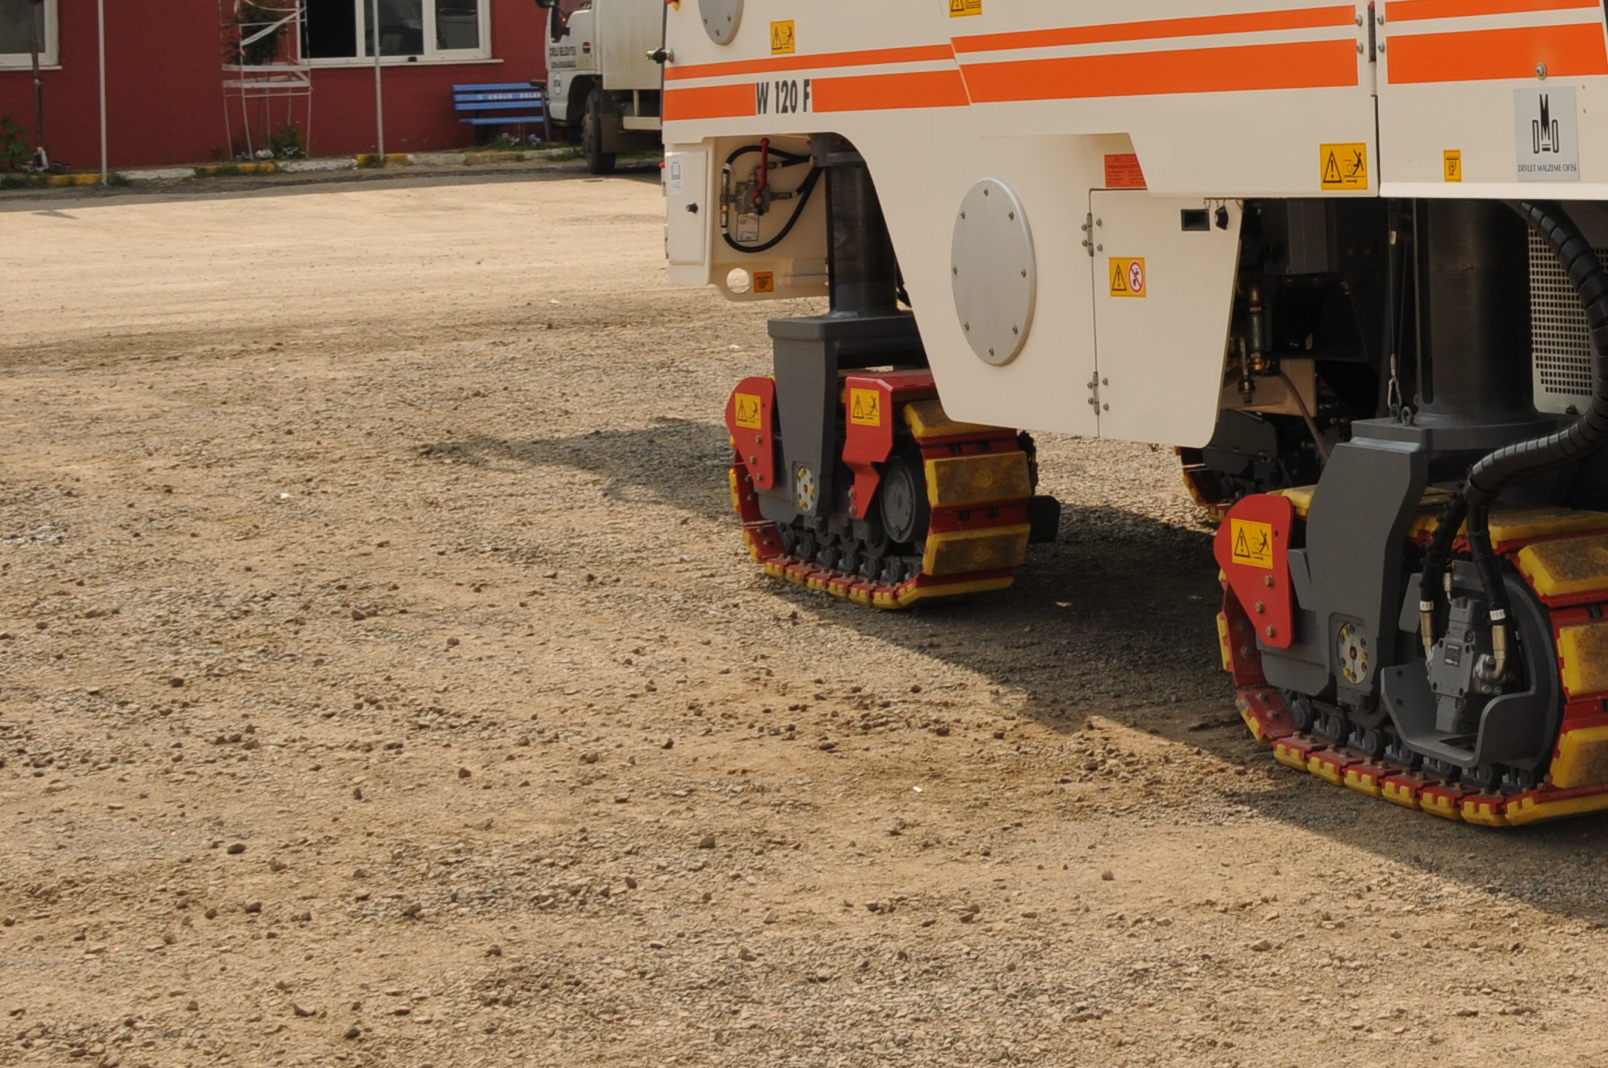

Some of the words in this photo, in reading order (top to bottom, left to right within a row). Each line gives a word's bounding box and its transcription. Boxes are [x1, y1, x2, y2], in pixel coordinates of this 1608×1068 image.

[756, 81, 770, 115] W
[775, 79, 798, 114] 120
[803, 78, 811, 112] F
[1537, 163, 1562, 172] MALZEME
